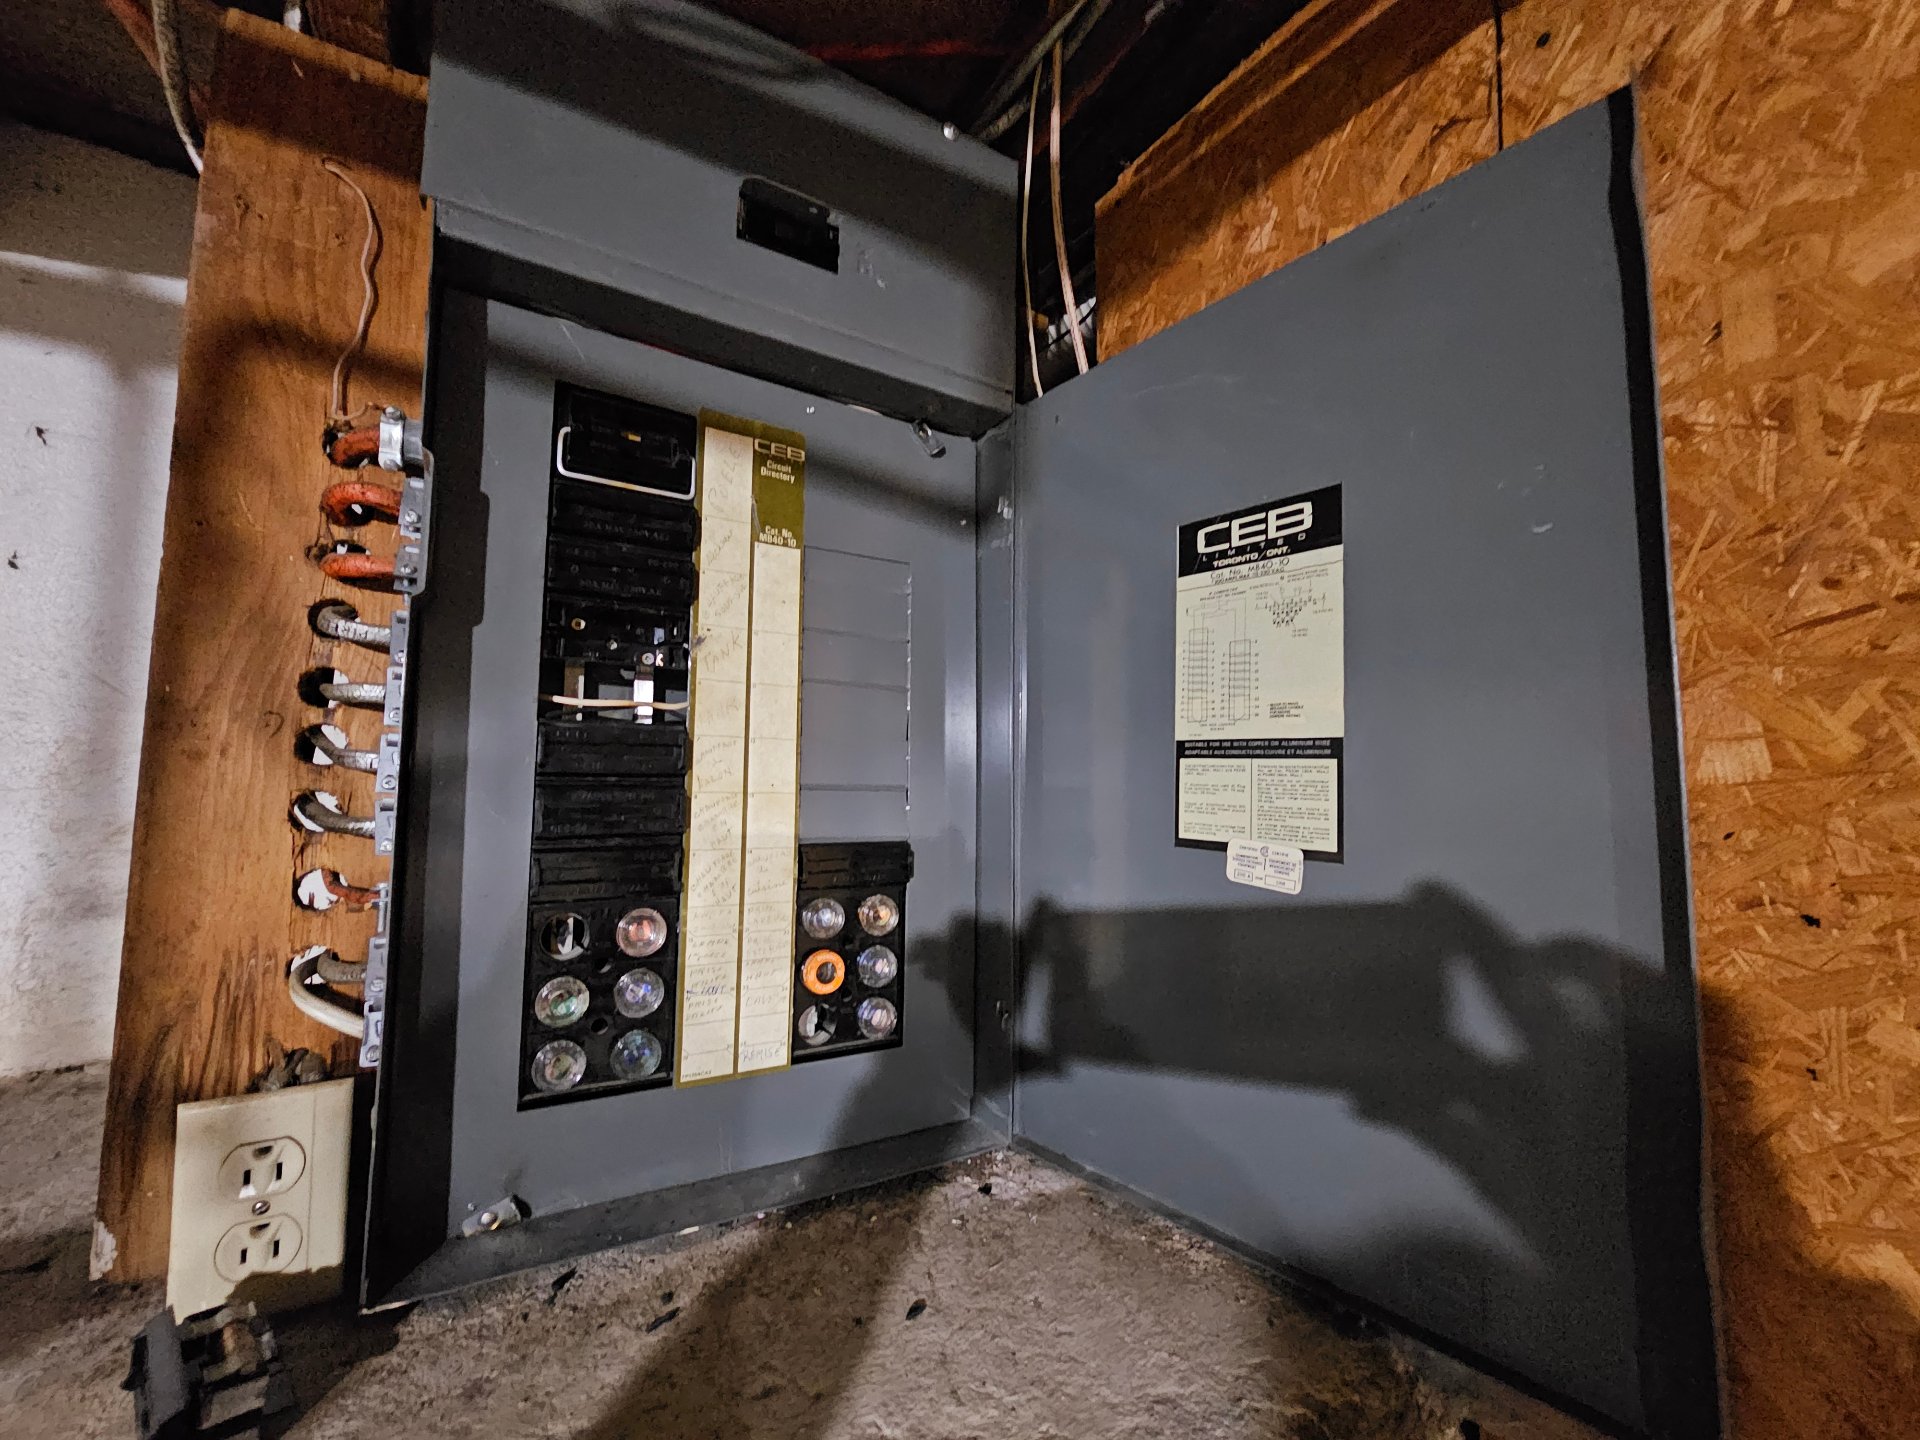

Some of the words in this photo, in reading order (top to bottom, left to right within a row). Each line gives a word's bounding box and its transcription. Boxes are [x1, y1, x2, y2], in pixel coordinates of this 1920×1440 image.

[754, 438, 805, 461] CEB
[761, 466, 796, 484] Directory
[767, 459, 792, 473] Circuit
[1197, 500, 1313, 554] CEB
[759, 532, 797, 548] MB40-10
[1202, 532, 1306, 562] LIMITED
[704, 630, 743, 673] TANK
[742, 1047, 781, 1064] REMISE
